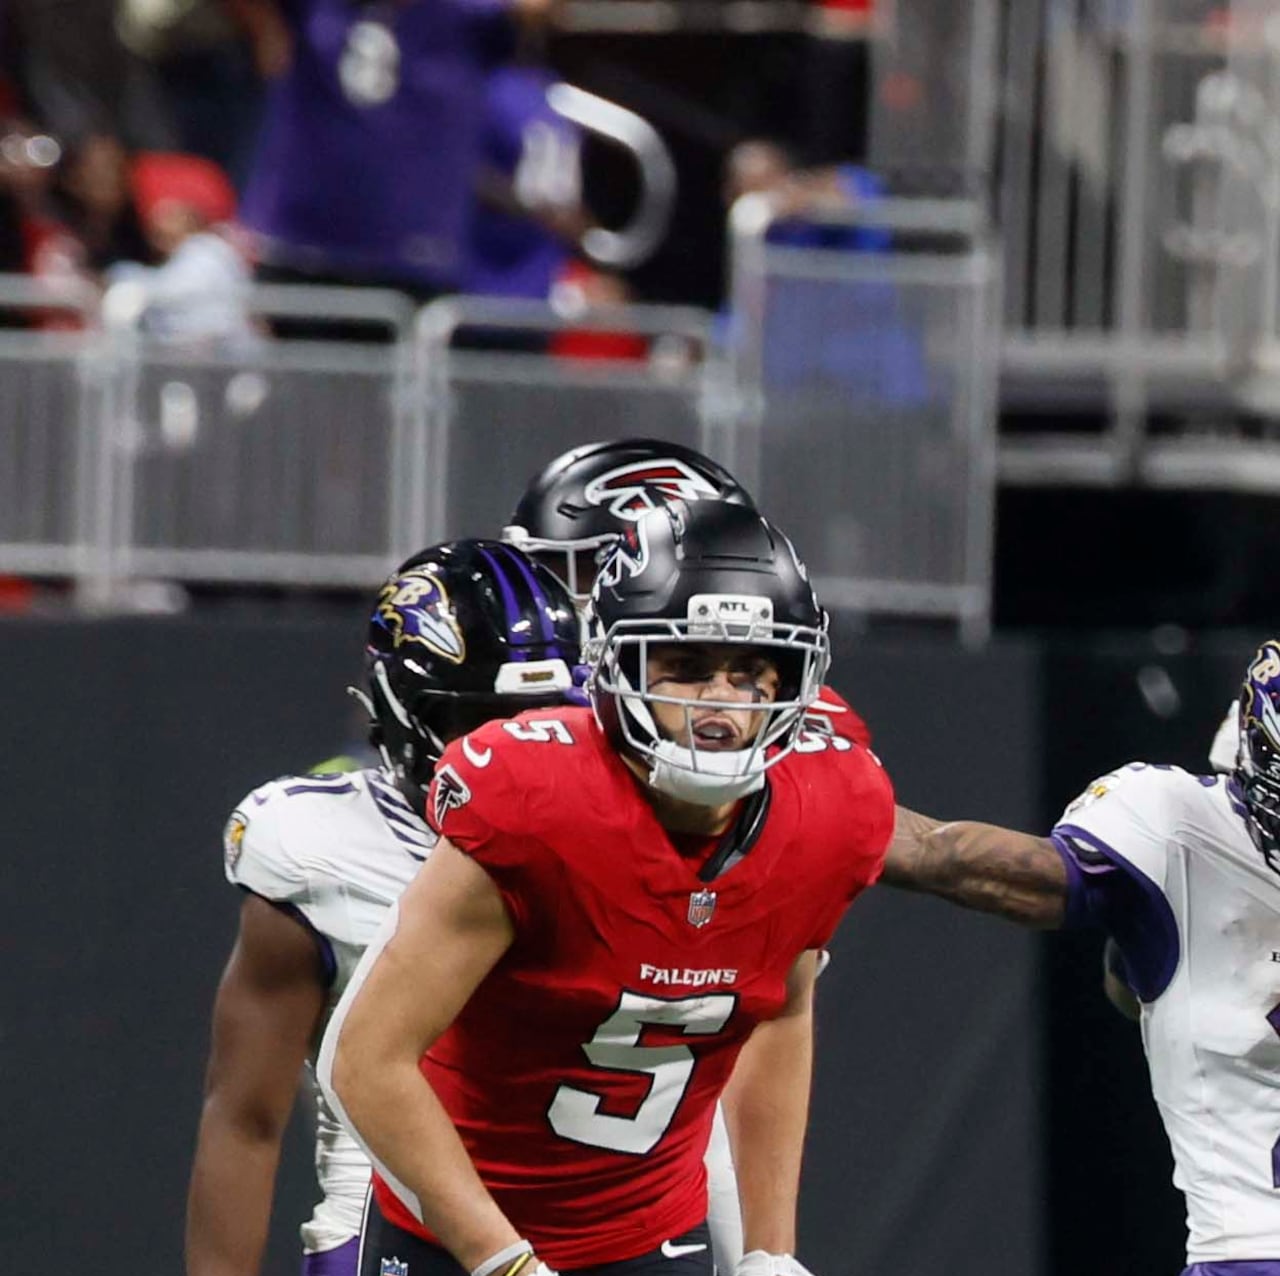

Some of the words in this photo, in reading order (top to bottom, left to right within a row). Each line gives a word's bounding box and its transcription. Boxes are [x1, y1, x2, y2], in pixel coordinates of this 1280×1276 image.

[719, 601, 749, 612] ATL
[640, 963, 738, 987] FALCONS
[546, 988, 738, 1156] 5
